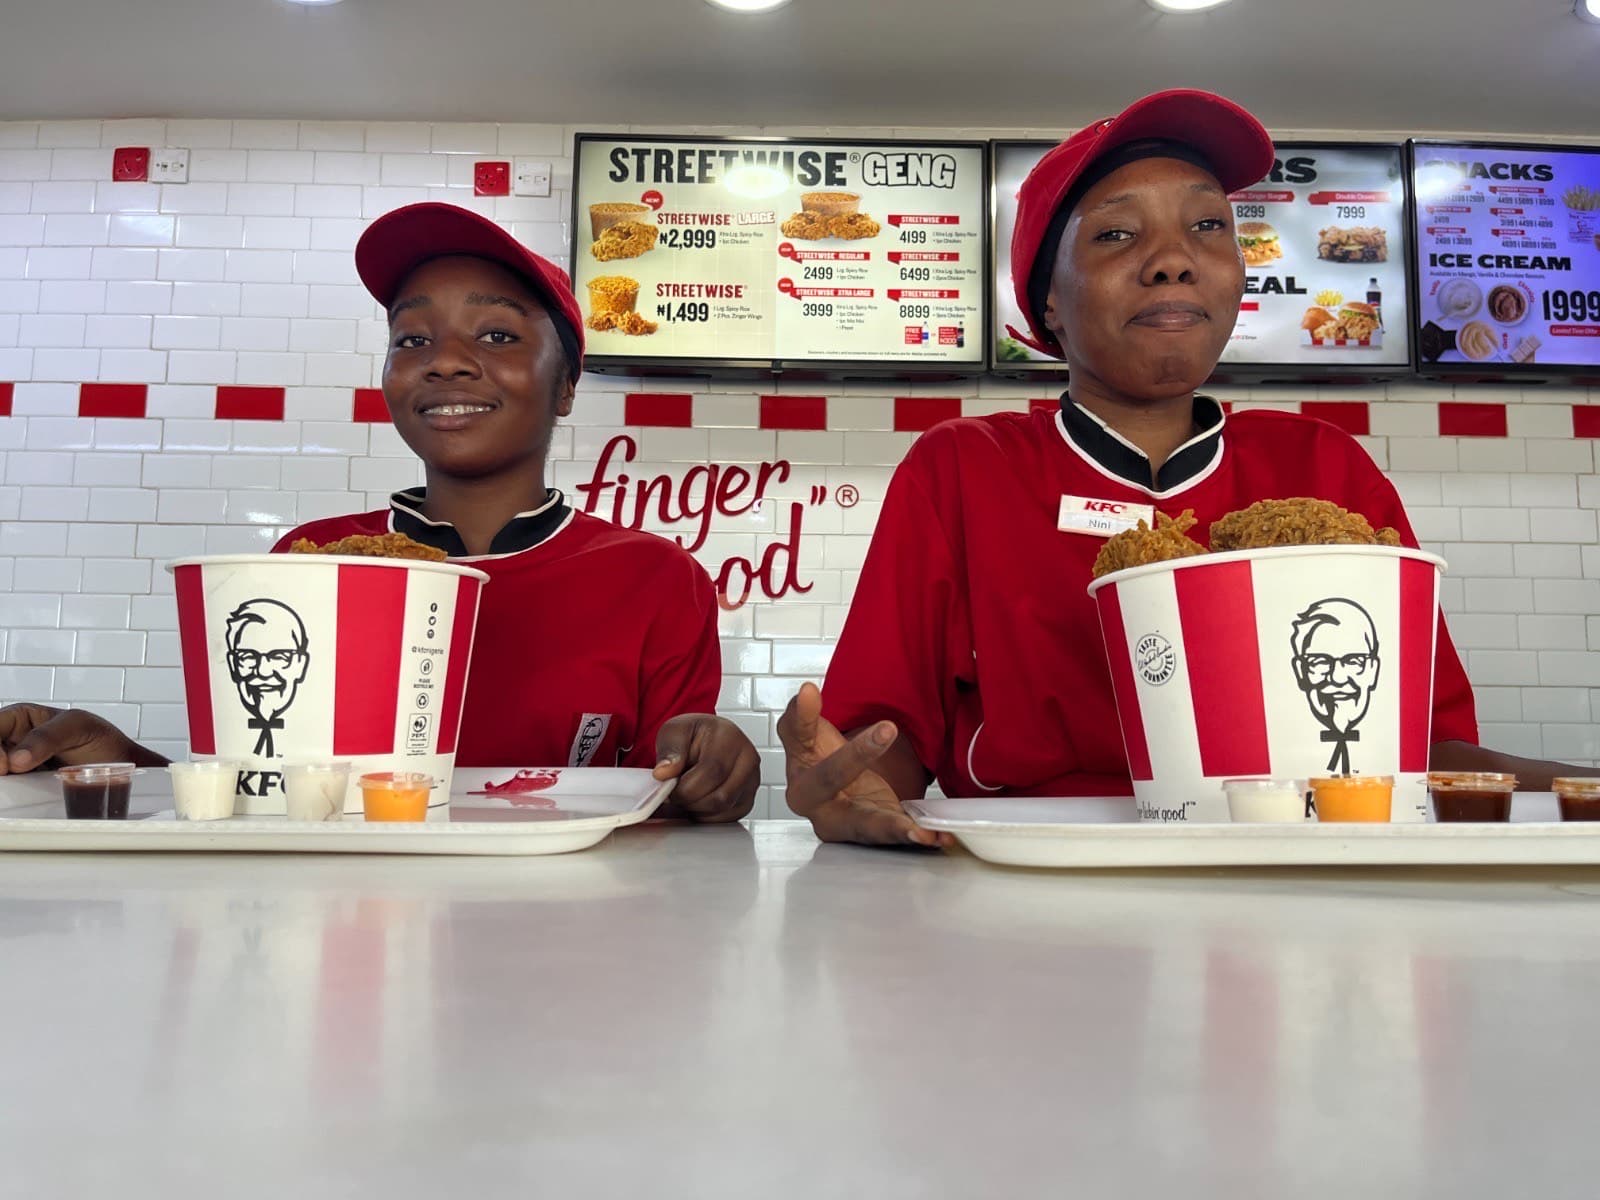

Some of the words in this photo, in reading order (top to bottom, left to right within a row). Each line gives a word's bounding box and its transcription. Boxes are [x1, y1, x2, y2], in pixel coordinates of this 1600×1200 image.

[862, 152, 957, 189] GENG
[737, 211, 776, 225] LARGE
[1236, 205, 1265, 218] 8299
[1336, 206, 1365, 218] 7999
[900, 230, 926, 244] 4199
[1429, 254, 1472, 268] ICE
[1477, 254, 1571, 271] CREAM
[804, 266, 833, 280] 2499
[900, 267, 930, 281] 6499
[1244, 276, 1307, 294] EAL
[803, 303, 833, 317] 3999
[900, 305, 930, 318] 8899
[1542, 290, 1600, 322] 1999
[576, 435, 790, 552] finger
[1088, 519, 1112, 530] Nini
[1138, 638, 1157, 655] TASTE
